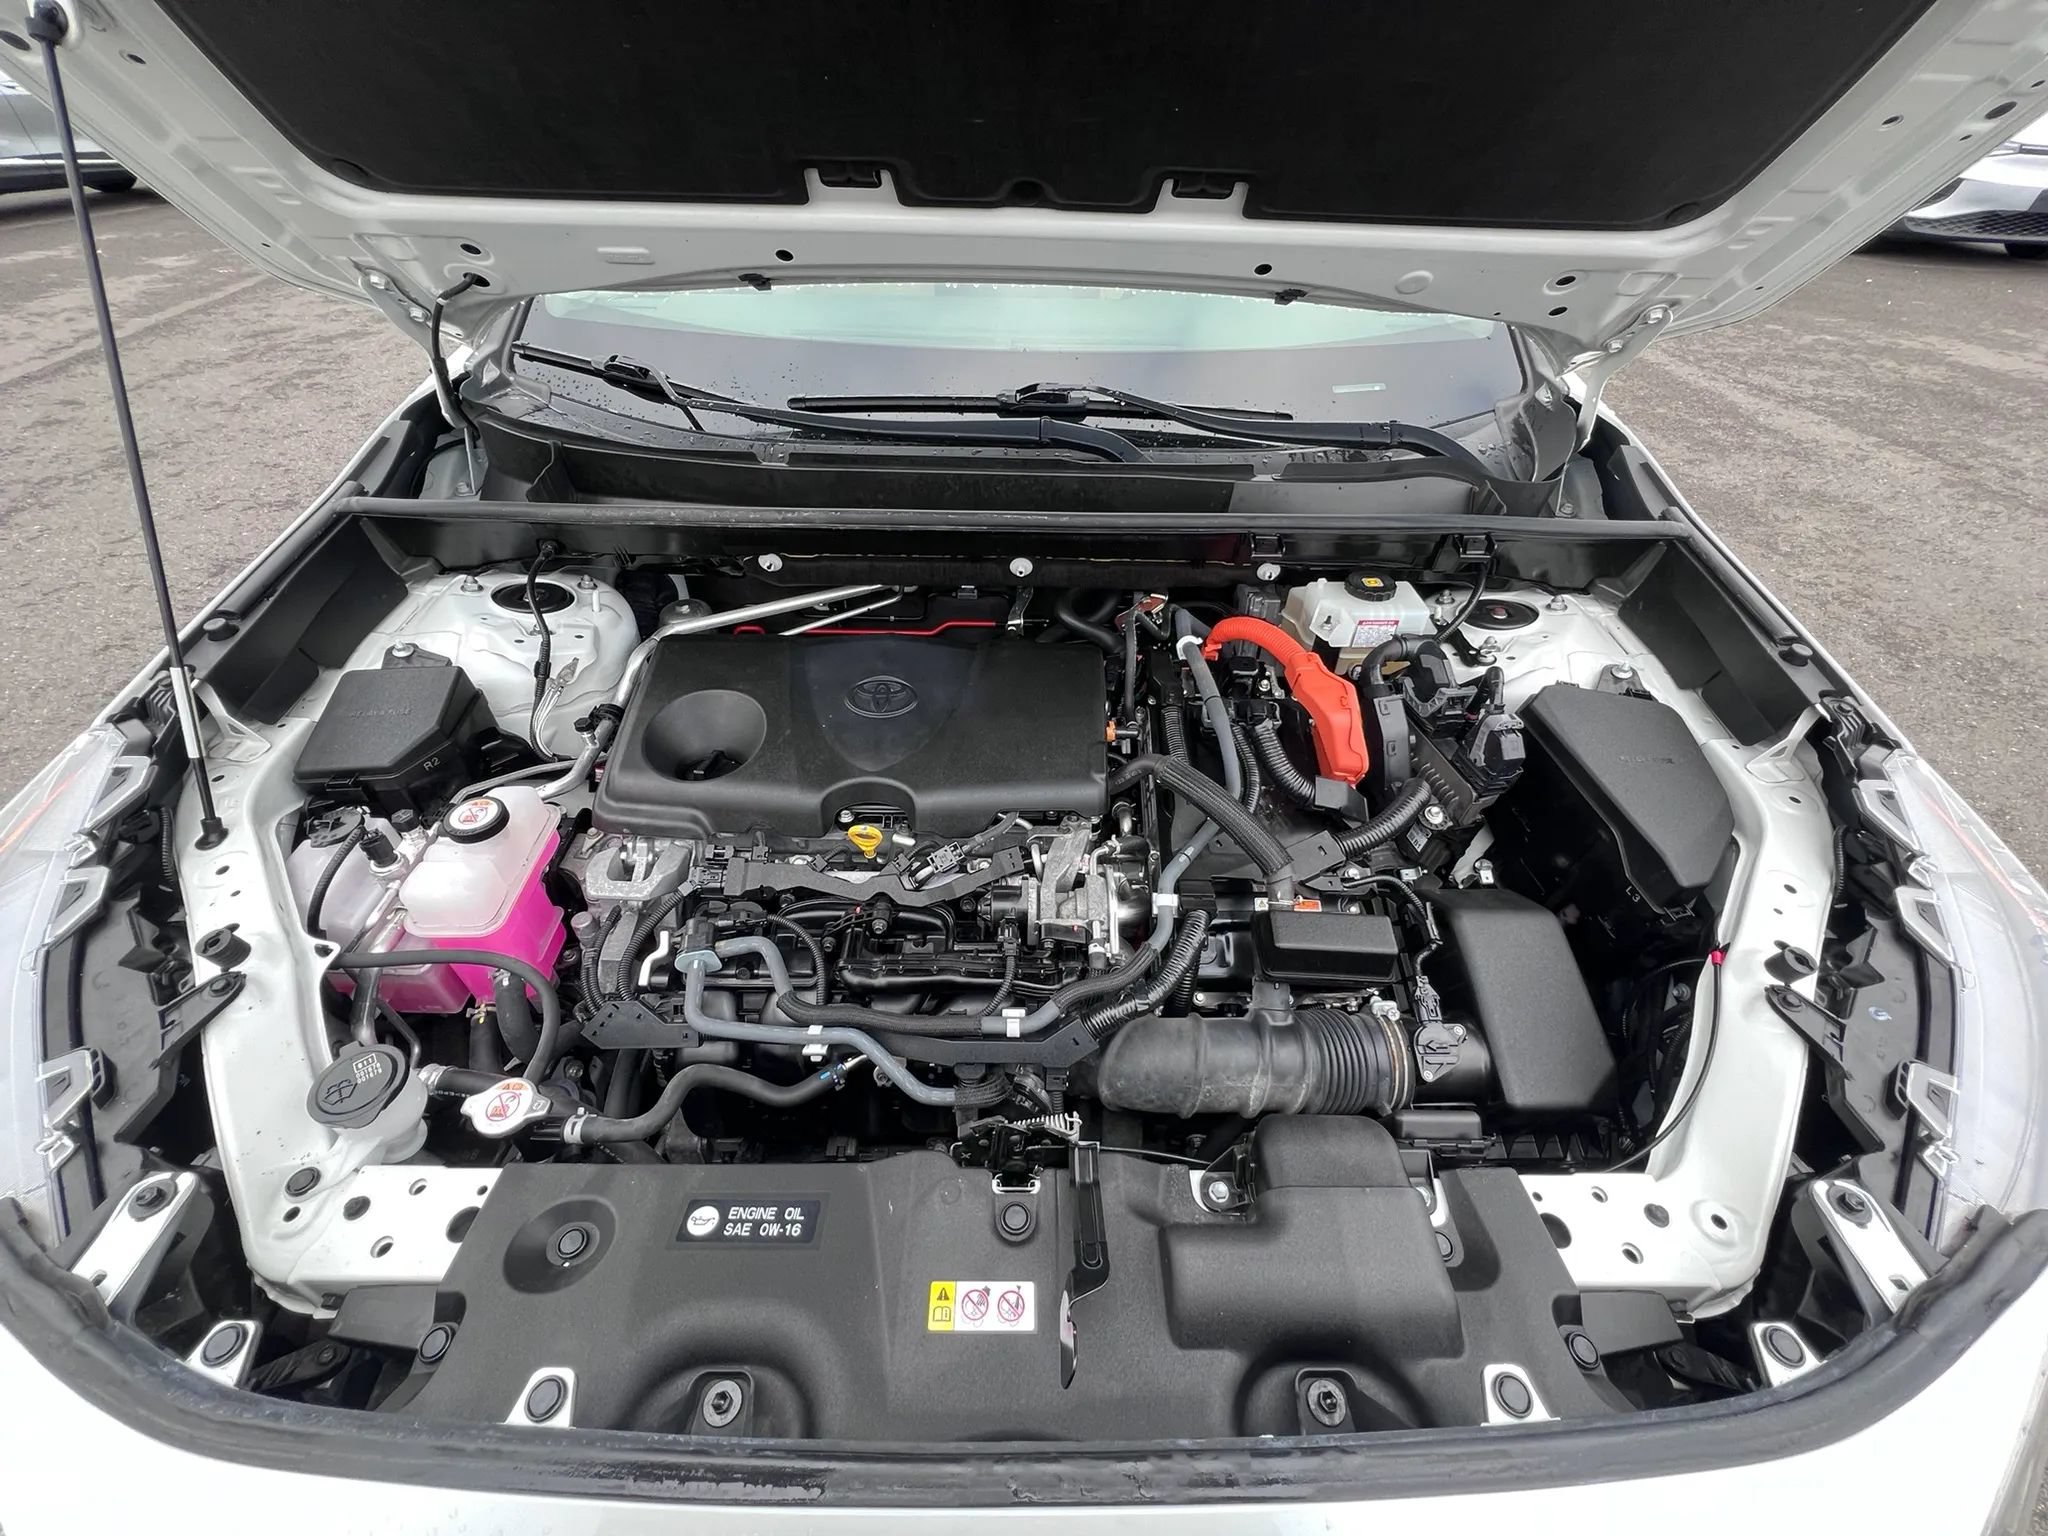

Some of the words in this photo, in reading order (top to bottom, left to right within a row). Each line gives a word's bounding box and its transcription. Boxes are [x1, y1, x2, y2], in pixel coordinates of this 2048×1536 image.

[423, 757, 441, 771] R2
[1626, 885, 1640, 903] L3
[727, 1206, 778, 1220] ENGINE
[784, 1207, 805, 1220] OIL
[723, 1222, 753, 1236] SAE
[759, 1223, 802, 1237] 0W-16
